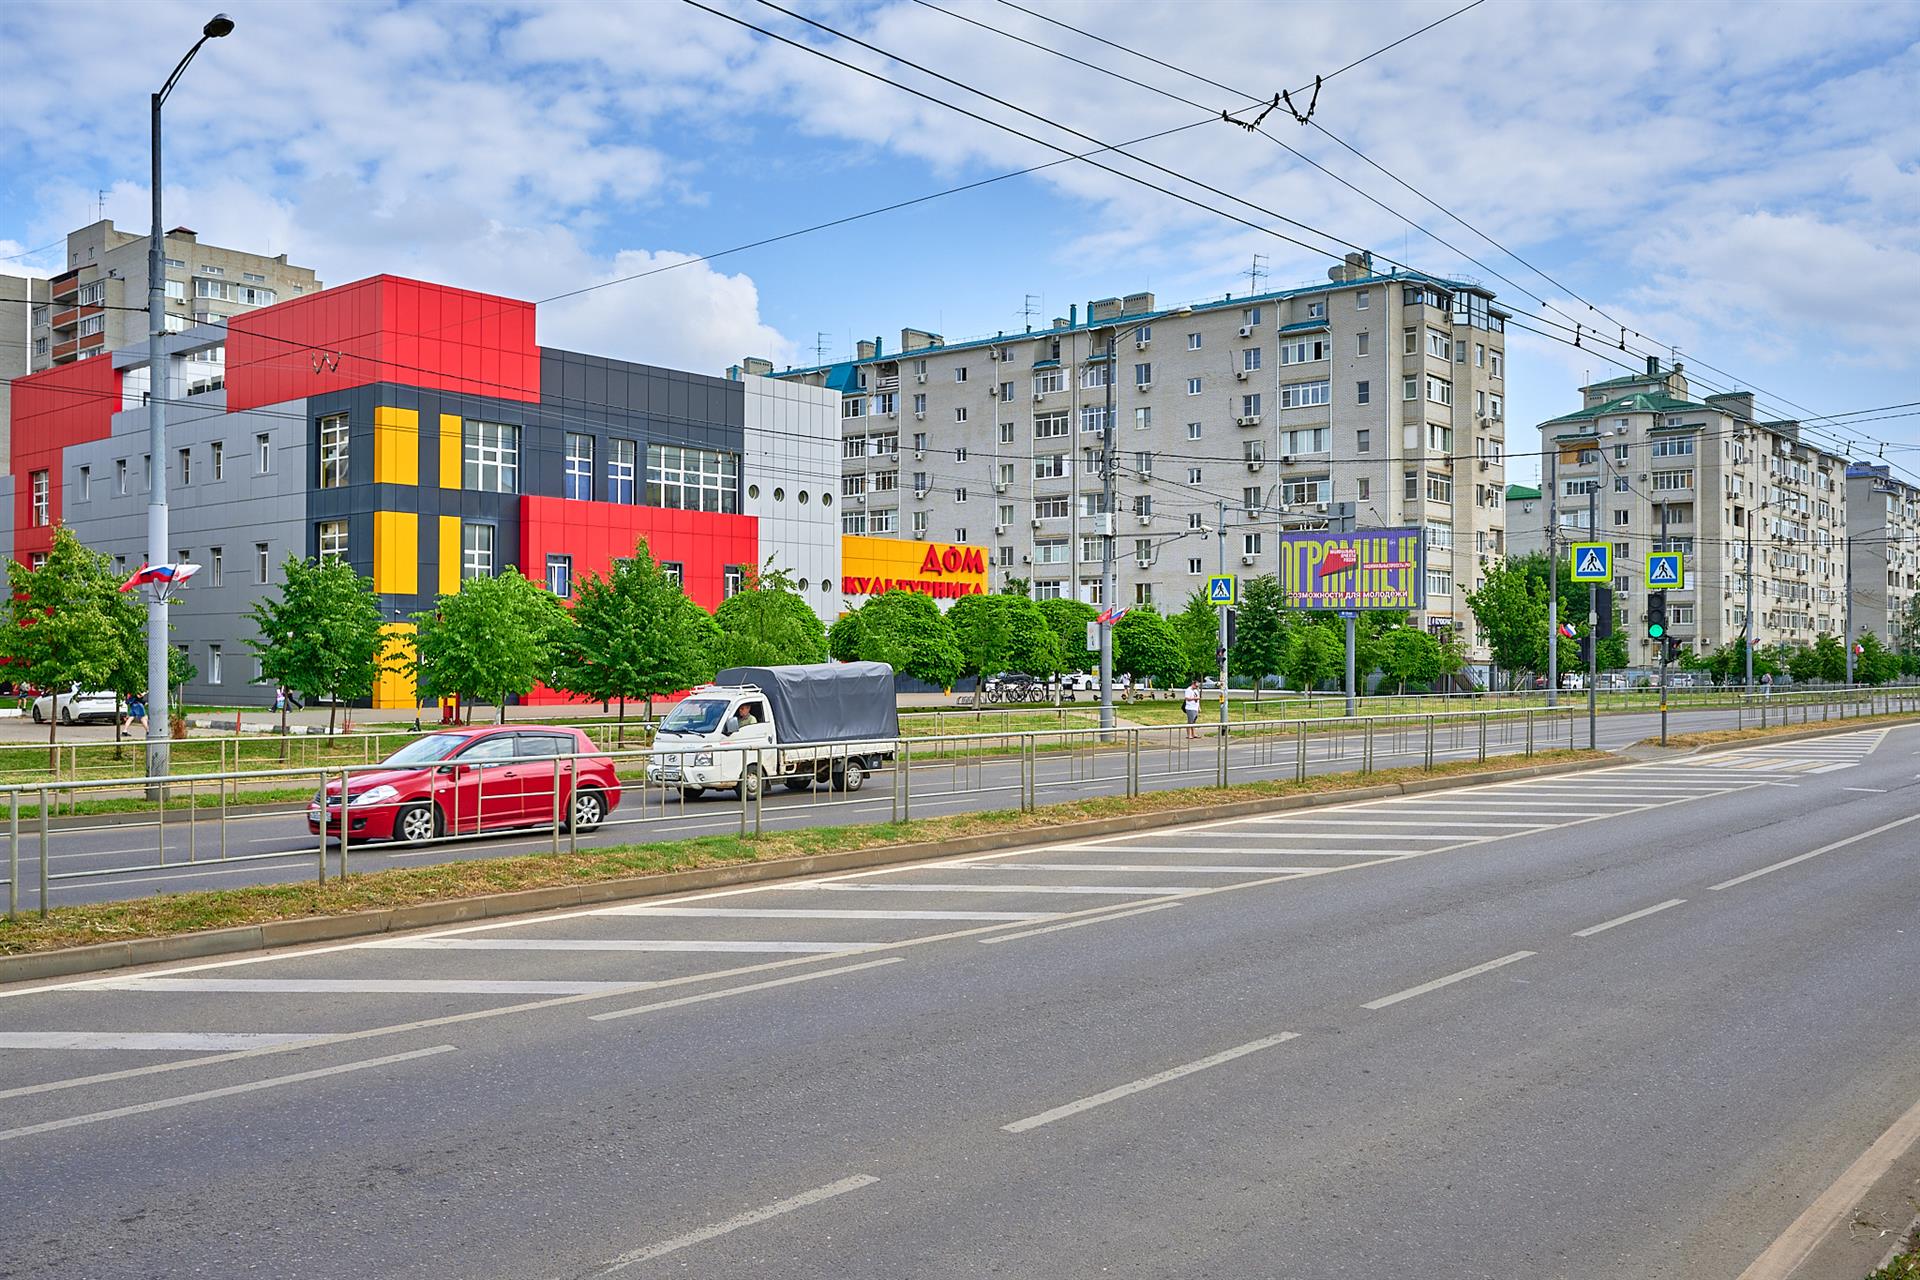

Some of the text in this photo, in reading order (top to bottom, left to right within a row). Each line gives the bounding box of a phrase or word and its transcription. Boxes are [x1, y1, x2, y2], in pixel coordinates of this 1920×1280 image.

[920, 544, 984, 576] ДОМ
[1281, 536, 1417, 608] ОГРОМНЫЕ
[842, 576, 984, 599] КУЛТУРНИКА
